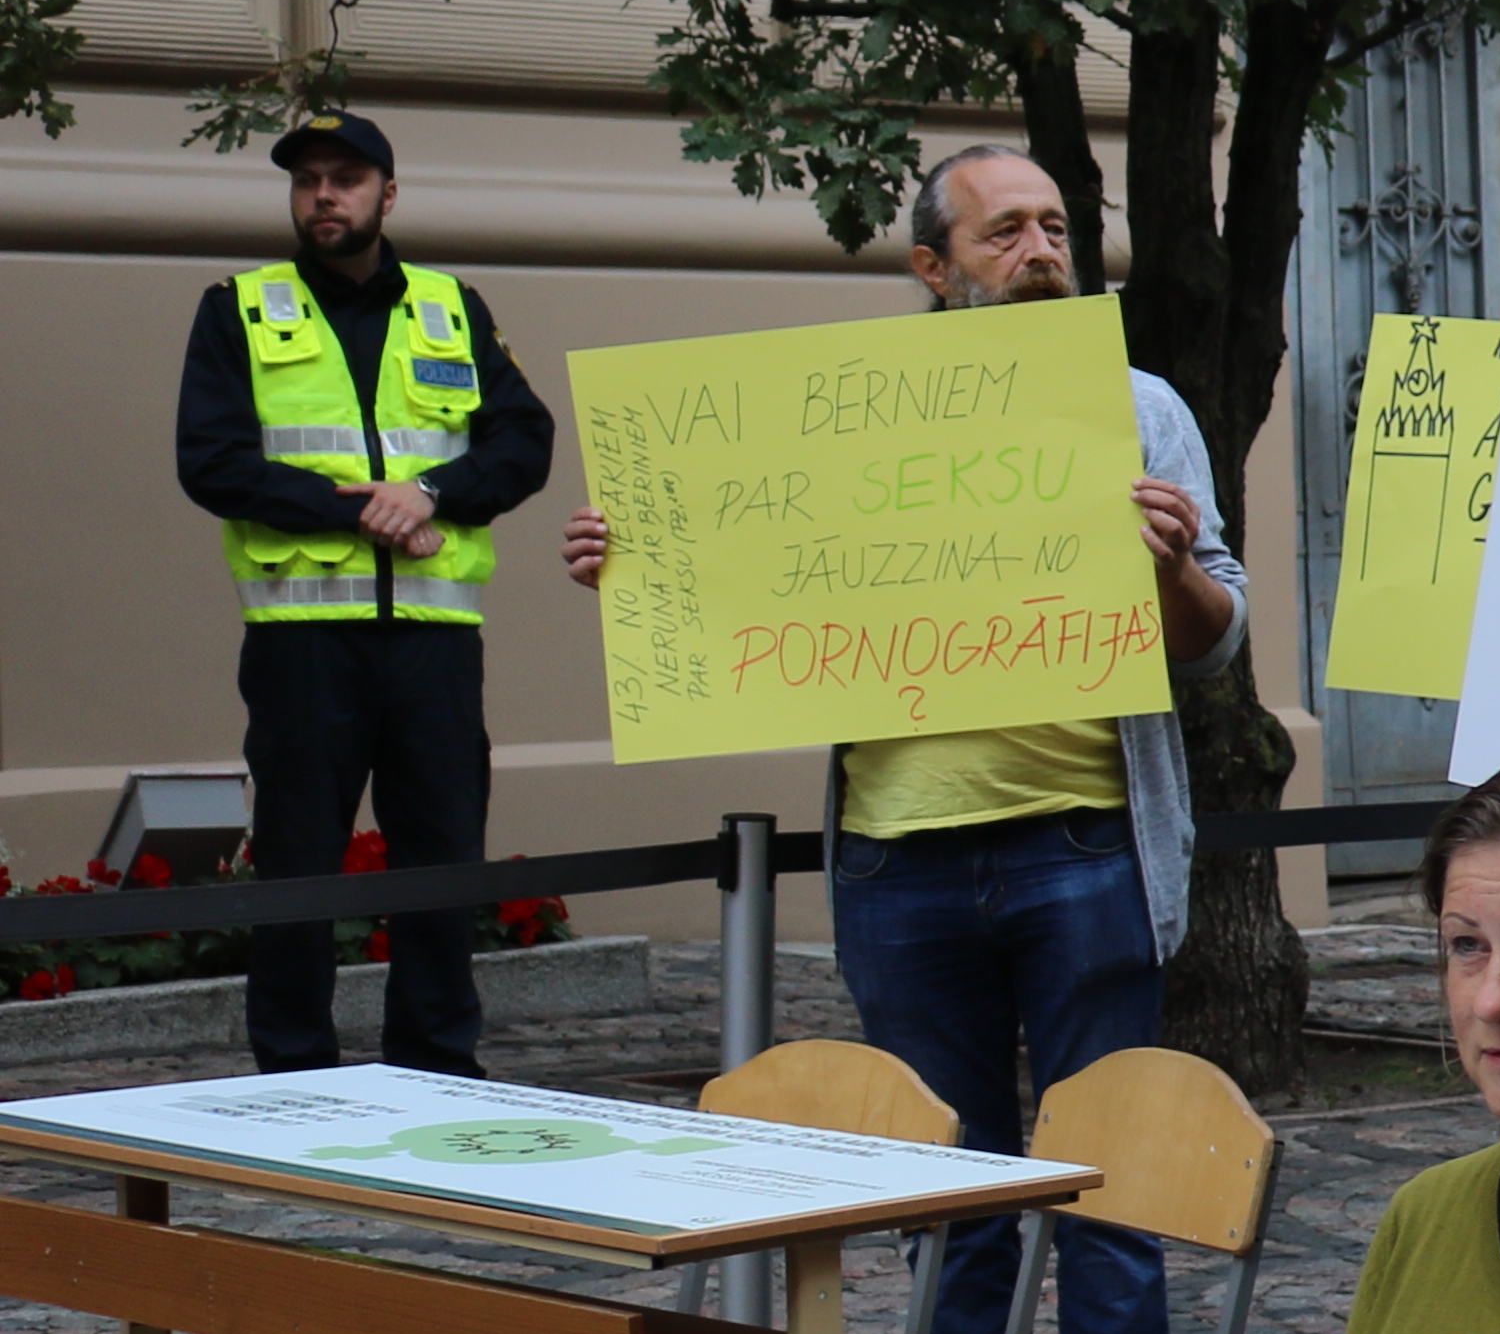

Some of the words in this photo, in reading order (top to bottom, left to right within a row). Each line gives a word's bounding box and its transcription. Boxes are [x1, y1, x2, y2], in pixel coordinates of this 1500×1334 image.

[415, 359, 473, 388] POLICIJA
[645, 381, 741, 445] VAI
[801, 357, 1018, 436] BĒRNIEM
[715, 470, 815, 530] PAR
[852, 446, 1075, 516] SEKSU
[643, 537, 668, 568] AR
[771, 532, 1022, 597] JĀUZZINA
[1034, 532, 1080, 575] NO
[614, 588, 642, 629] NO
[674, 548, 704, 635] SEKSU
[643, 571, 682, 697] NERUNĀ
[731, 593, 1161, 694] PORNOGRĀFIJAS
[687, 652, 711, 701] PAR
[898, 685, 927, 733] ?
